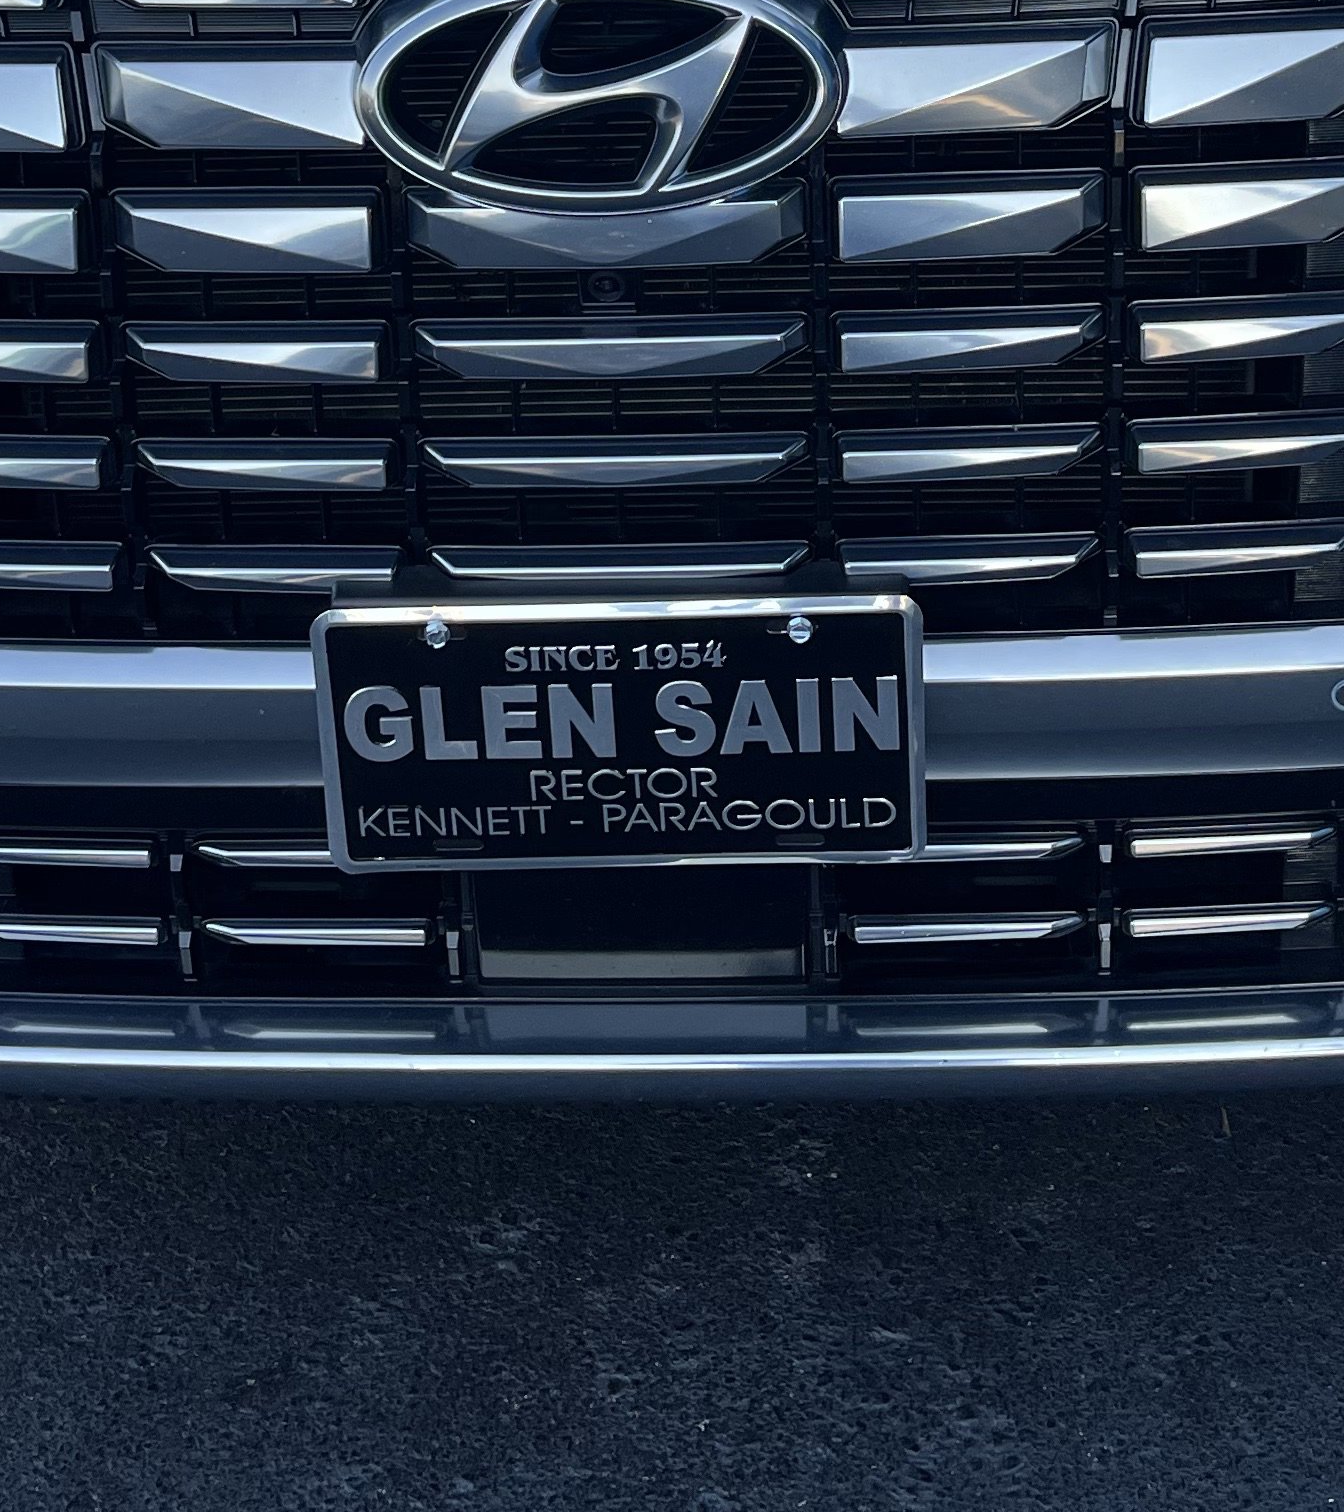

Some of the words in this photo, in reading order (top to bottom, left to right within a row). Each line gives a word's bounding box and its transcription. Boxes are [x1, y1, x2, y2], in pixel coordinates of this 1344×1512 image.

[505, 644, 620, 672] SINCE
[632, 639, 727, 671] 1954
[343, 683, 617, 762] GLEN
[655, 675, 900, 757] SAIN
[529, 767, 718, 802] RECTOR
[357, 804, 552, 837] KENNETT
[602, 797, 897, 833] PARAGOULD
